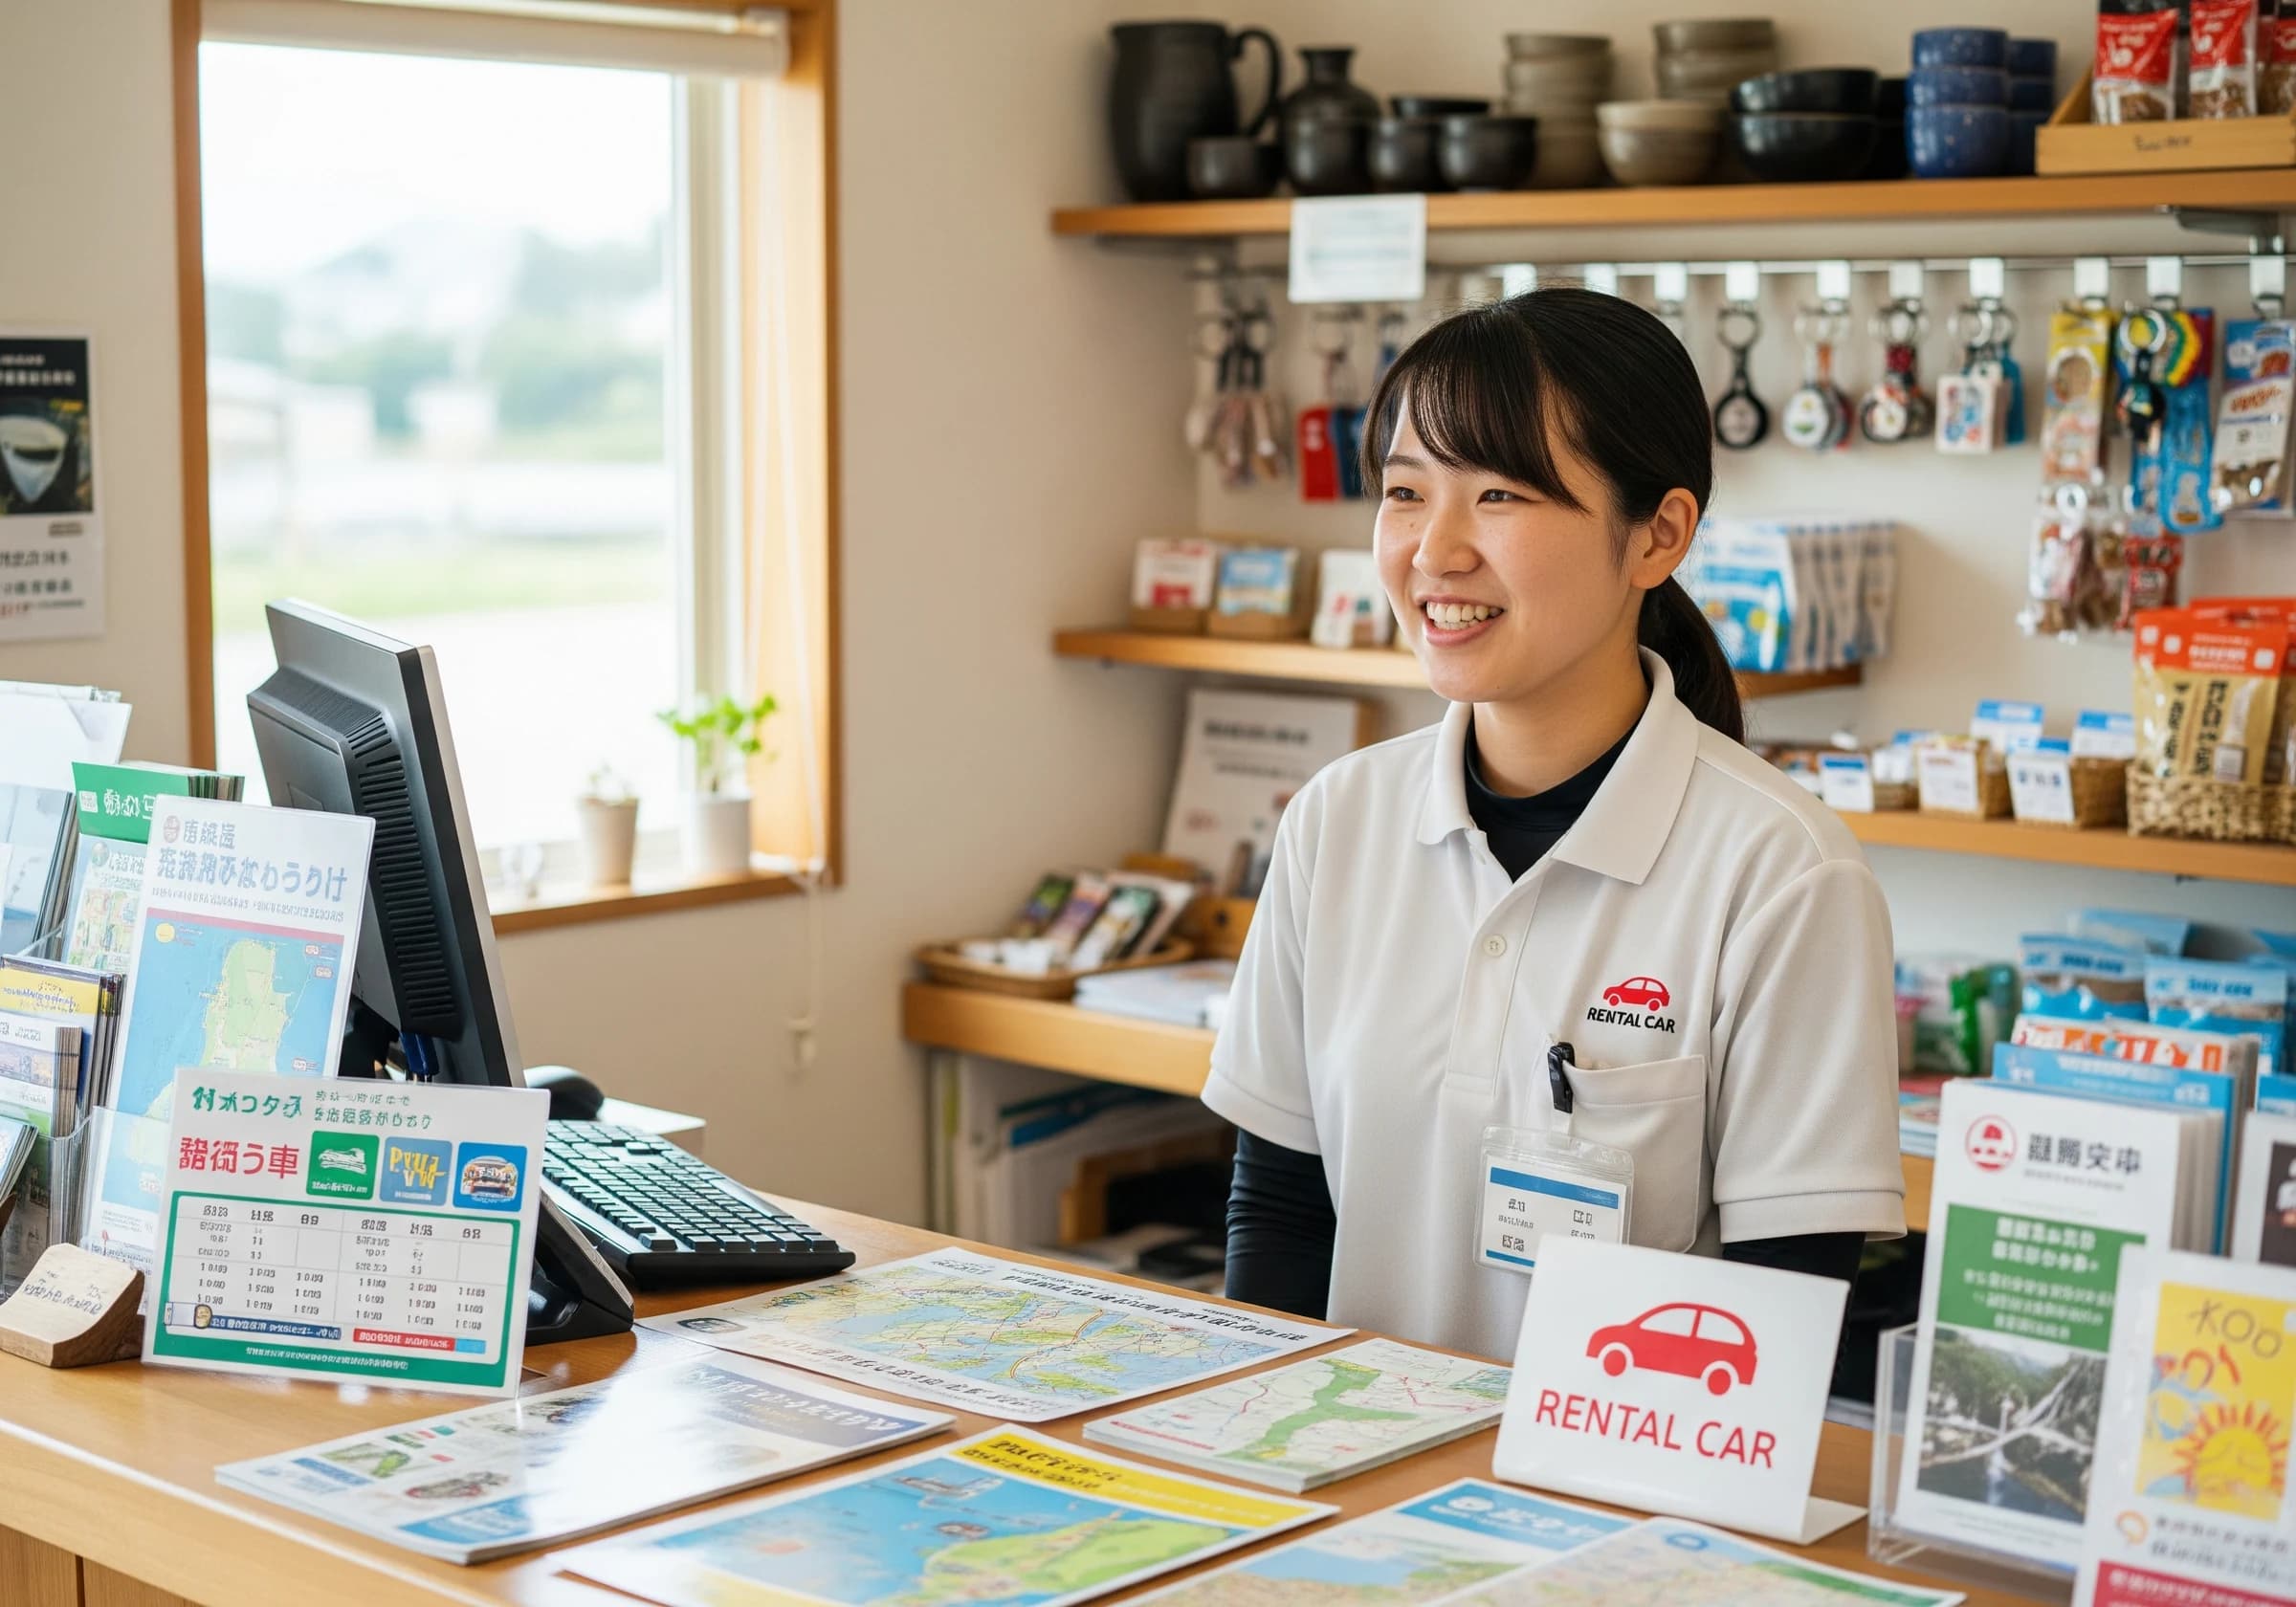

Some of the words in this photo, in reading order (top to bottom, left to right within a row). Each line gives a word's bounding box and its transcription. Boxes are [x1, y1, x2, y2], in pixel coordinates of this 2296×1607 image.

[1587, 1007, 1641, 1028] RENTAL
[1645, 1015, 1676, 1033] CAR
[1535, 1389, 1682, 1451] RENTAL
[1696, 1421, 1777, 1469] CAR
